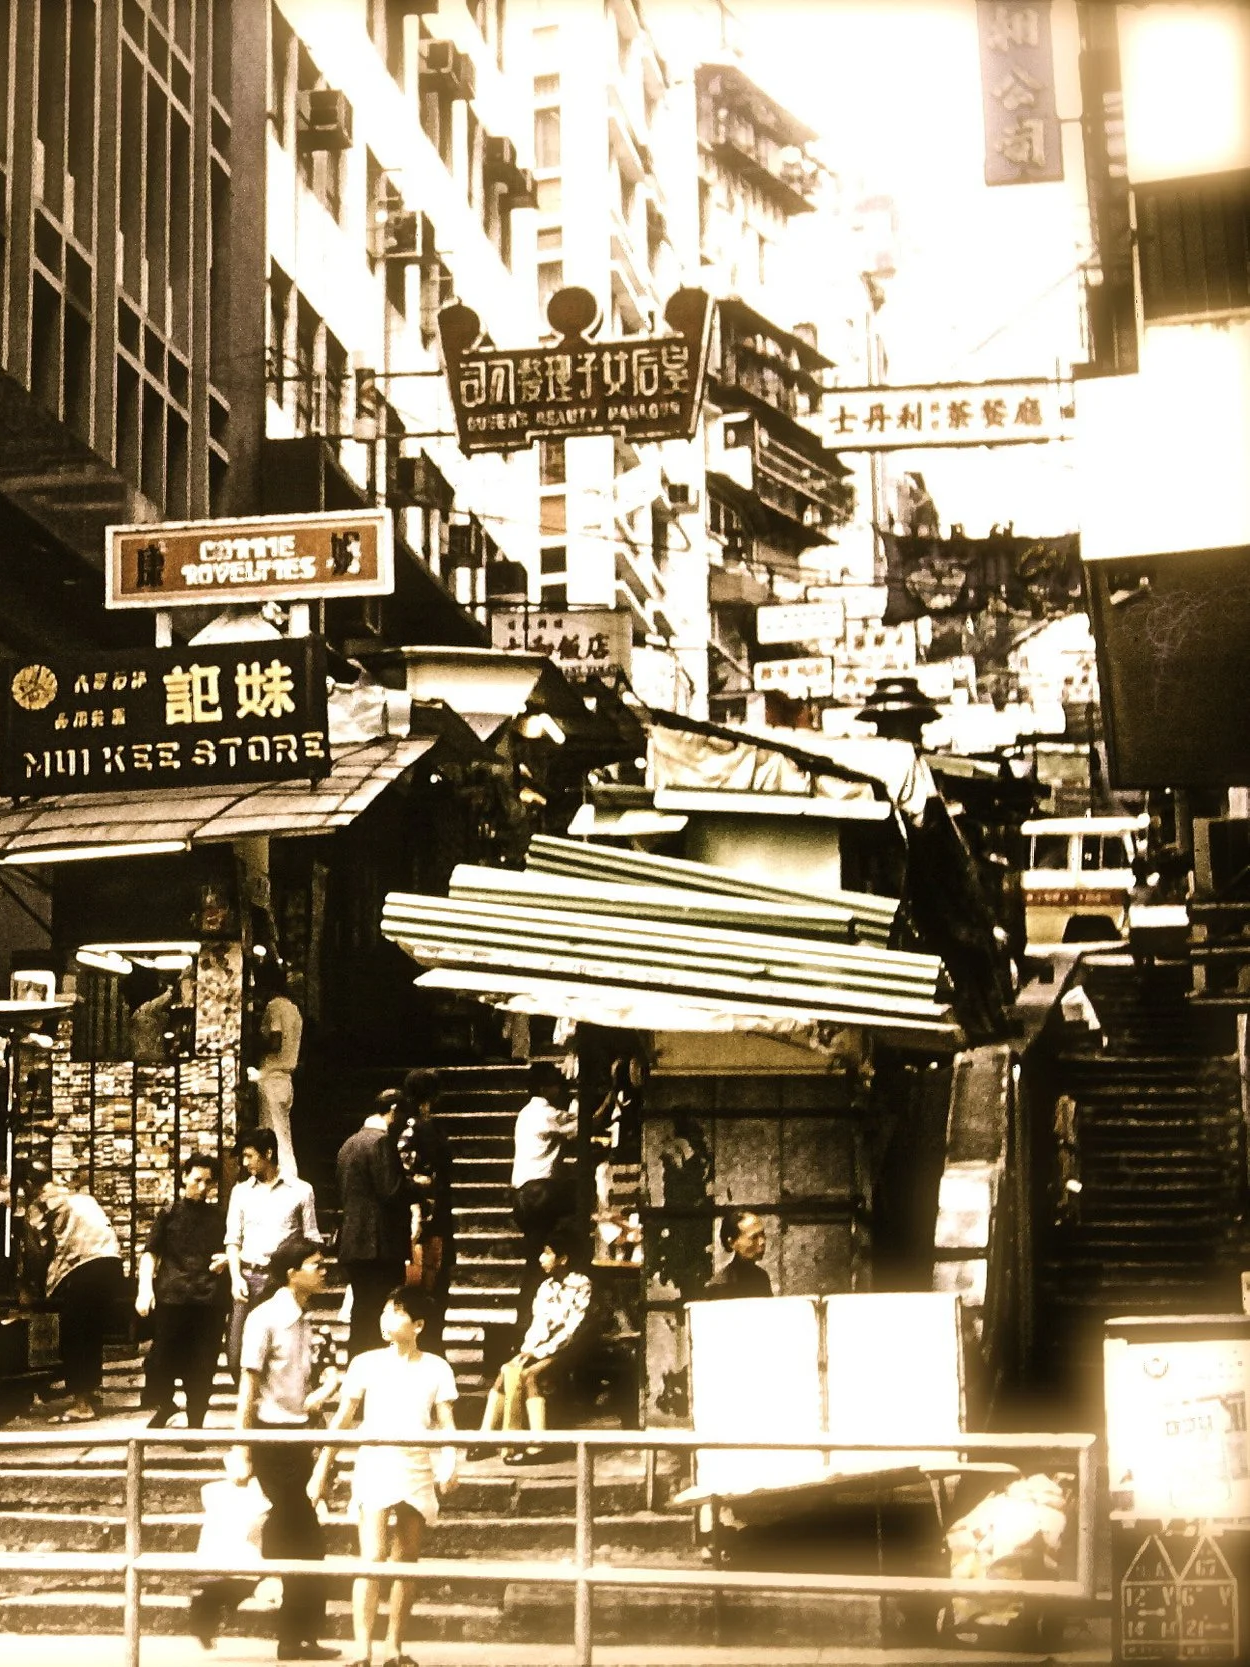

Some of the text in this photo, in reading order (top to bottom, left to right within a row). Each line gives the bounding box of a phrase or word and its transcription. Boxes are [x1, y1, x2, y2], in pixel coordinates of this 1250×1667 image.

[536, 407, 597, 427] BEAUTY
[102, 742, 181, 773] KEE
[191, 731, 326, 768] STORE
